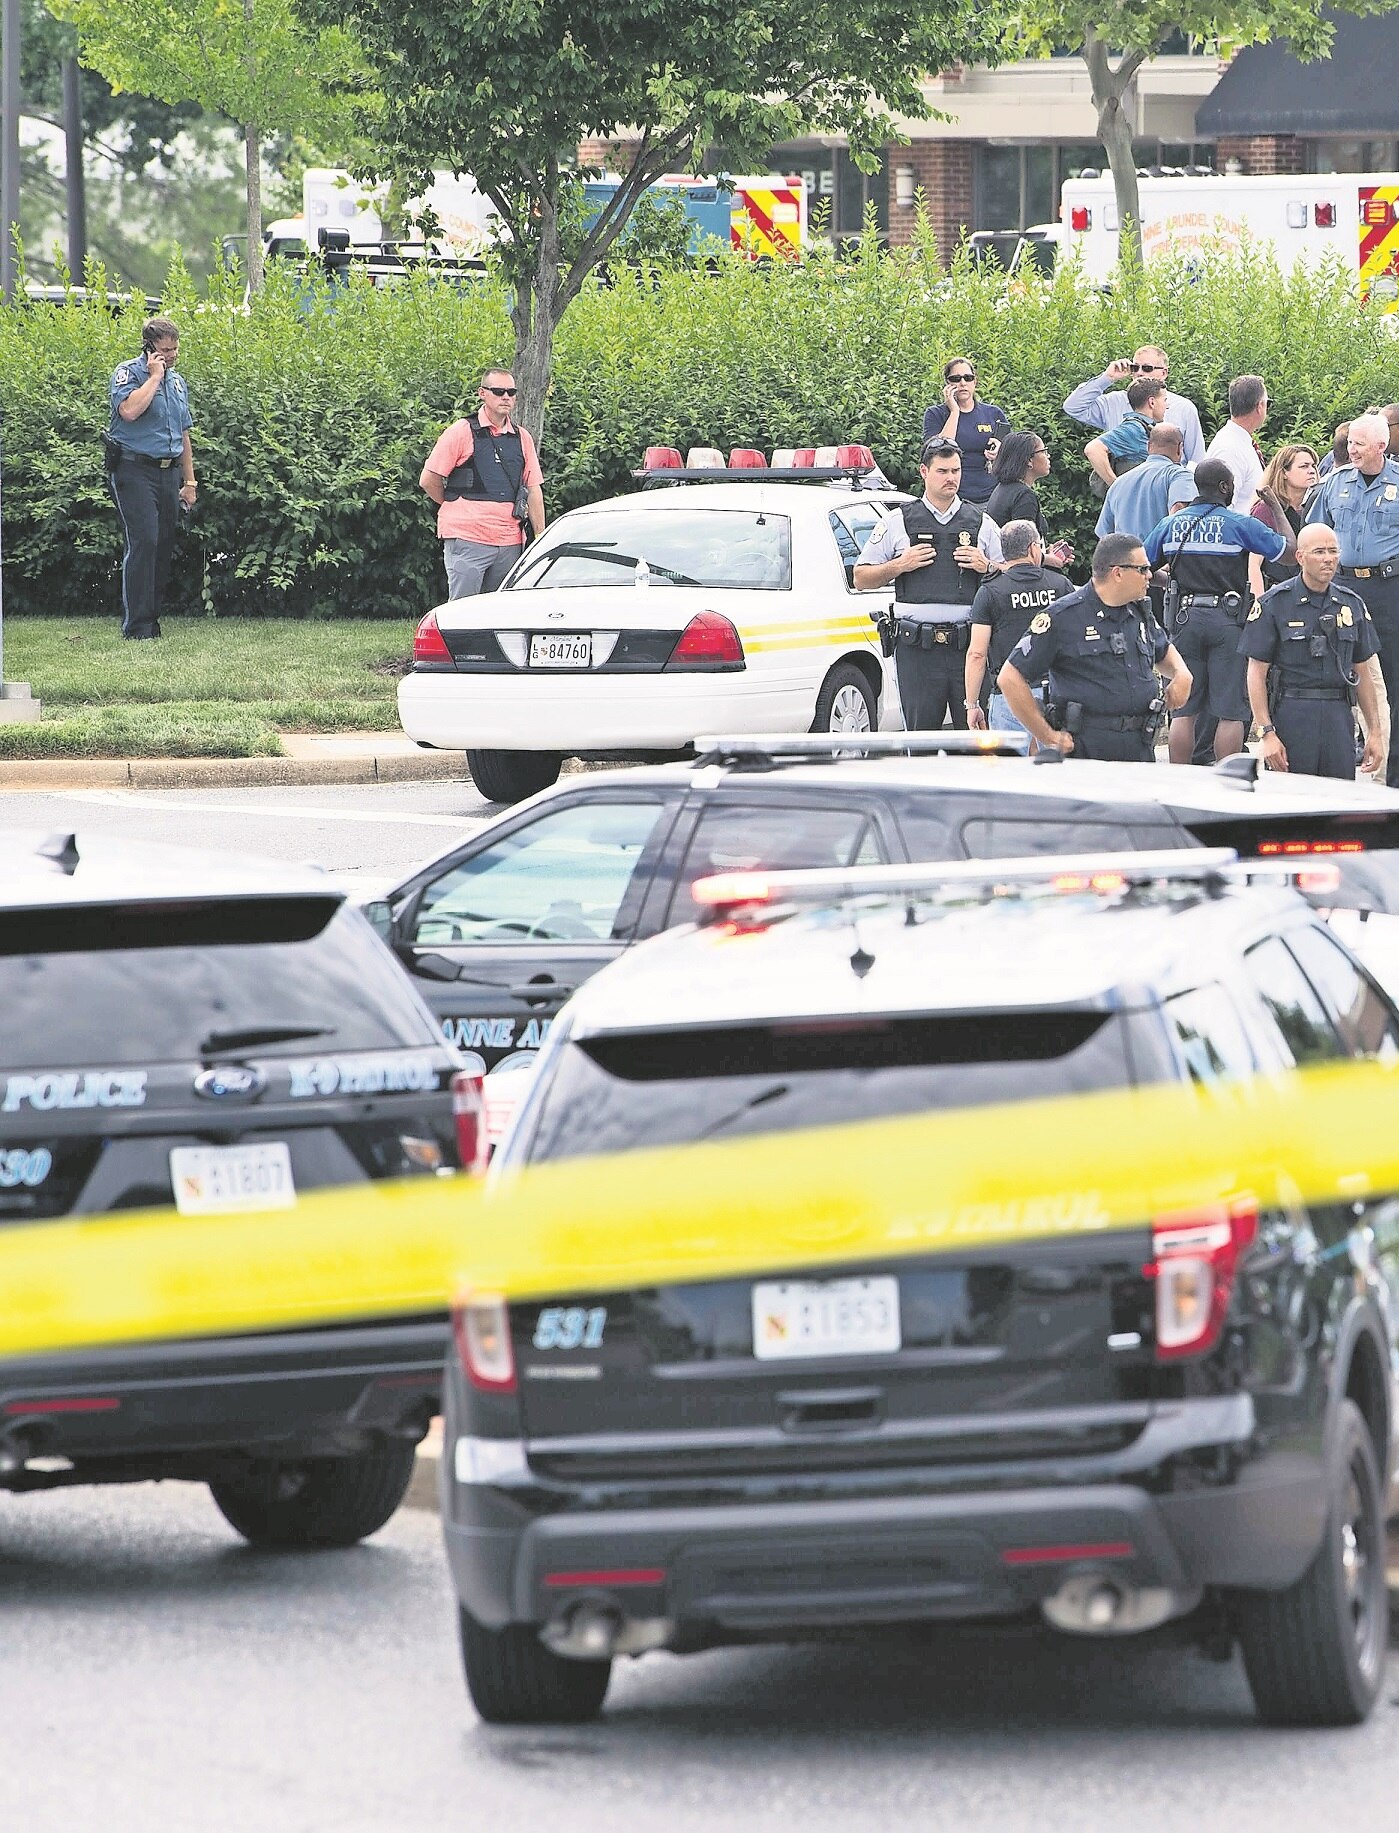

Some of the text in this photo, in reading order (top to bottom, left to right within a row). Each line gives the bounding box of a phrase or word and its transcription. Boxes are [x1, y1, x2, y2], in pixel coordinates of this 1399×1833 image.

[977, 424, 993, 433] FBI
[1172, 520, 1225, 533] COUNTY
[1171, 531, 1224, 544] POLICE
[1010, 589, 1056, 609] POLICE
[549, 643, 587, 659] 84760
[443, 1018, 516, 1048] ANNE
[1, 1071, 148, 1112] POLICE
[532, 1307, 607, 1350] 531
